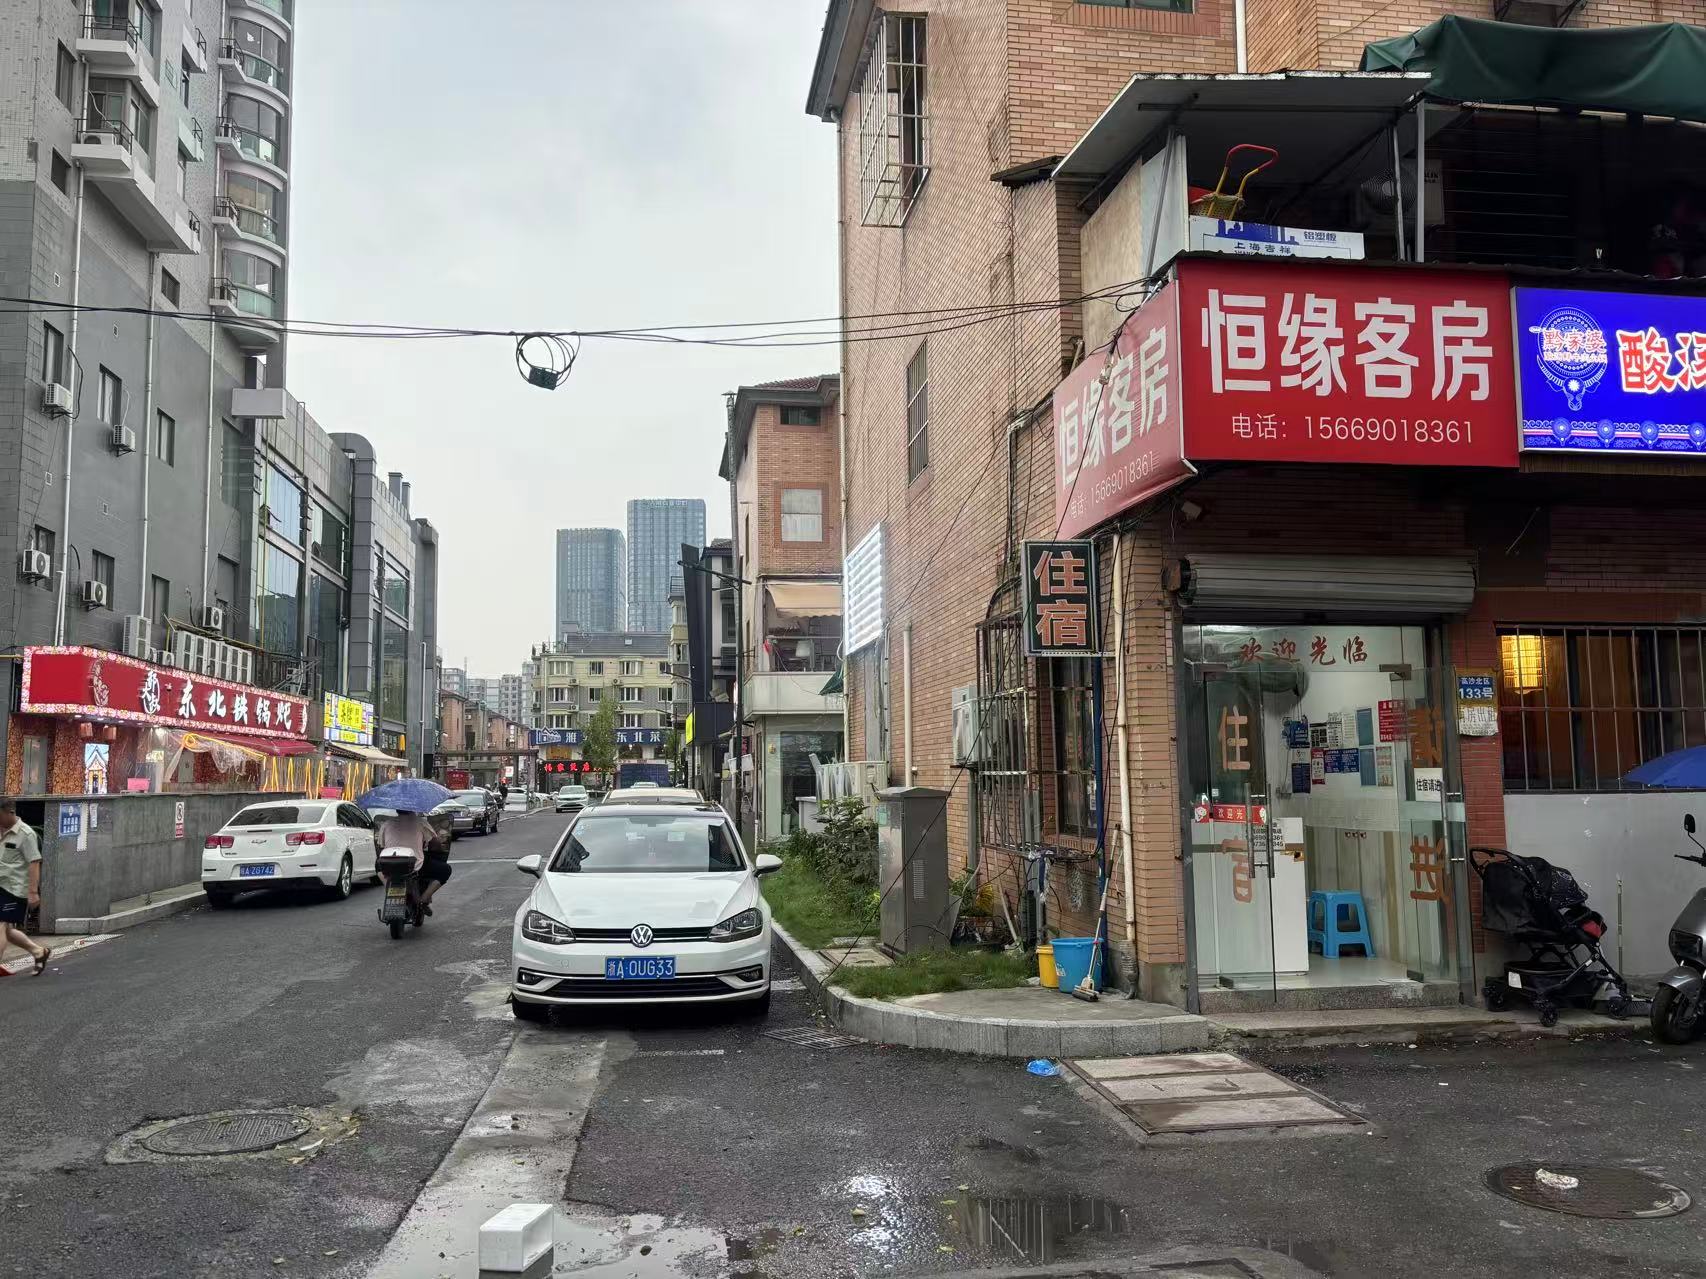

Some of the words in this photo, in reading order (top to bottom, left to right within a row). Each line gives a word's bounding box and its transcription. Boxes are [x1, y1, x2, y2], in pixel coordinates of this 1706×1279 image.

[1234, 241, 1292, 254] 上海吉祥
[1201, 288, 1494, 402] 恒缘客房
[1543, 328, 1608, 353] 黔家婆
[1059, 325, 1169, 491] 恒缘客房
[1034, 550, 1088, 646] 住宿
[1240, 635, 1368, 665] 欢迎光临
[1459, 686, 1495, 700] 133号
[1460, 677, 1491, 686] 高沙北区
[1218, 808, 1243, 820] 欢迎光
